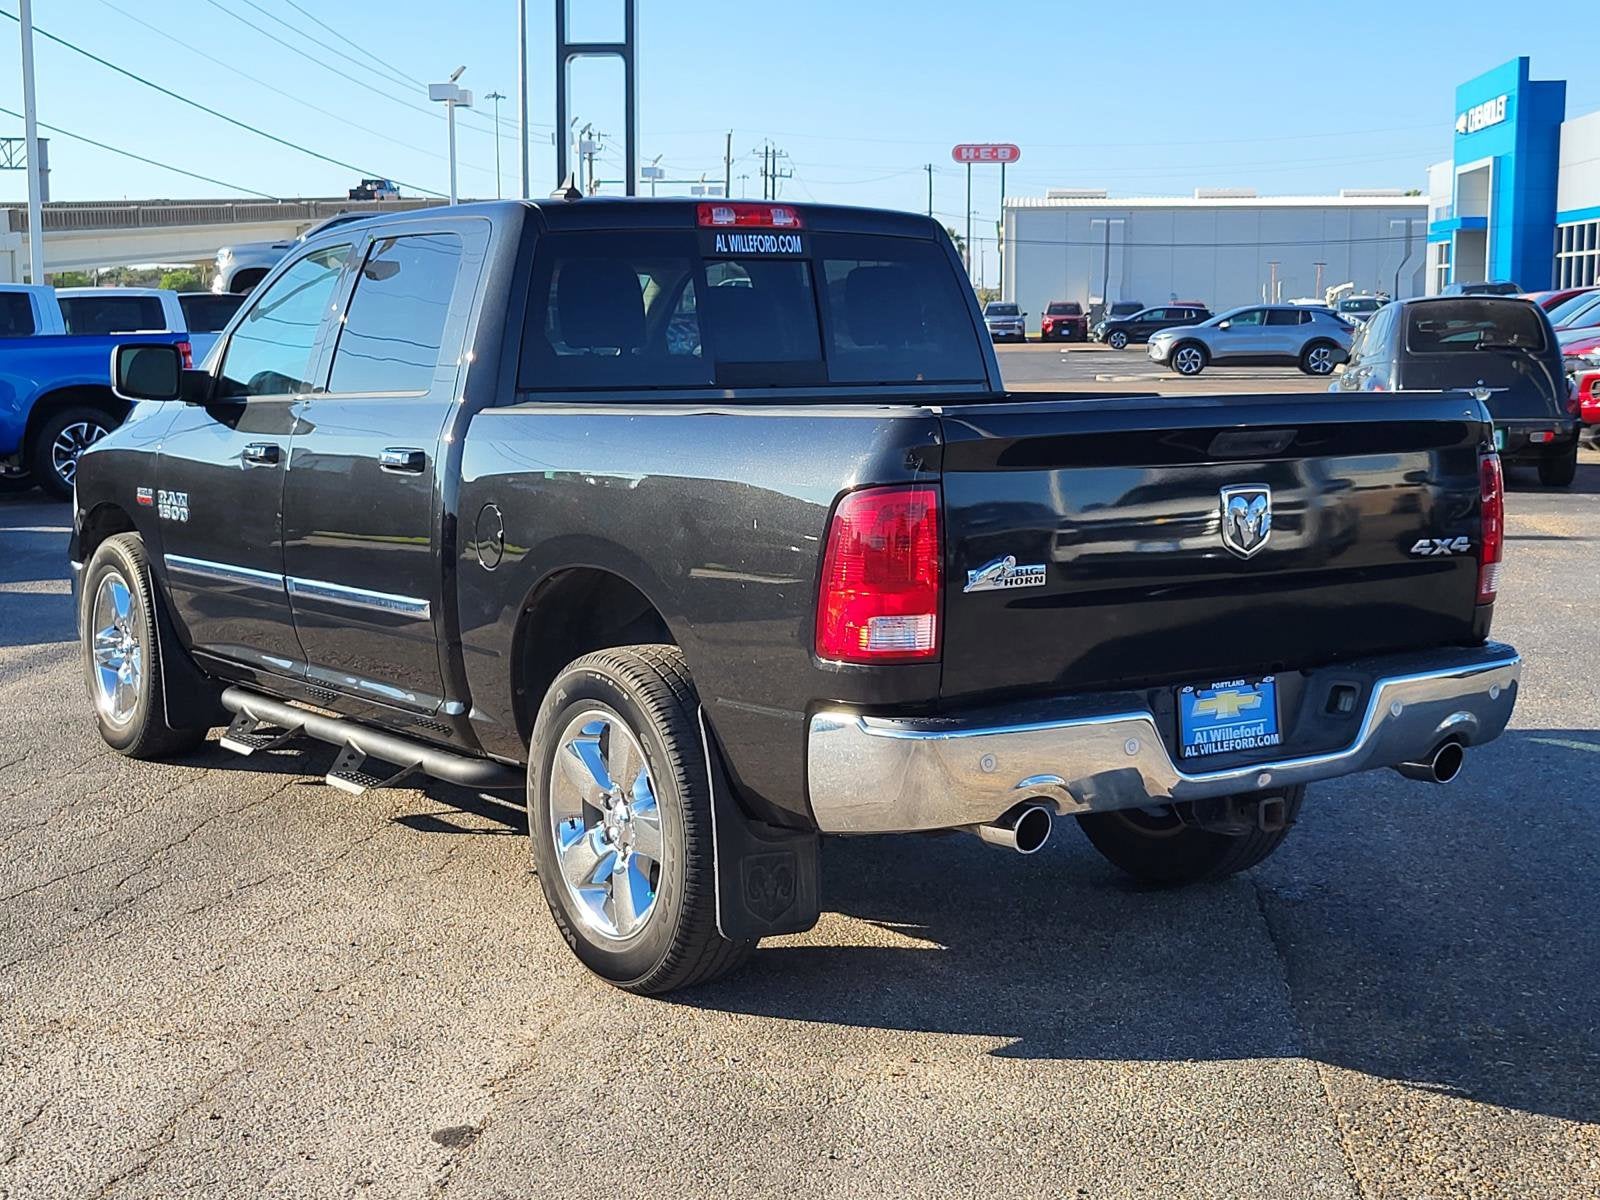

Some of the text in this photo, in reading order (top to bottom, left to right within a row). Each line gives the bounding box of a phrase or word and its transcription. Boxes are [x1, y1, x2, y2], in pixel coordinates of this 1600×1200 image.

[716, 233, 802, 253] AL WILLEFORD.COM
[158, 489, 188, 507] RAM
[158, 504, 188, 522] 1500
[1004, 575, 1043, 586] HORN
[1015, 567, 1039, 577] BIG
[1211, 680, 1245, 690] PORTLAND
[1195, 723, 1264, 745] Al Willeford
[1185, 734, 1279, 757] AL WILLEFORD.COM
